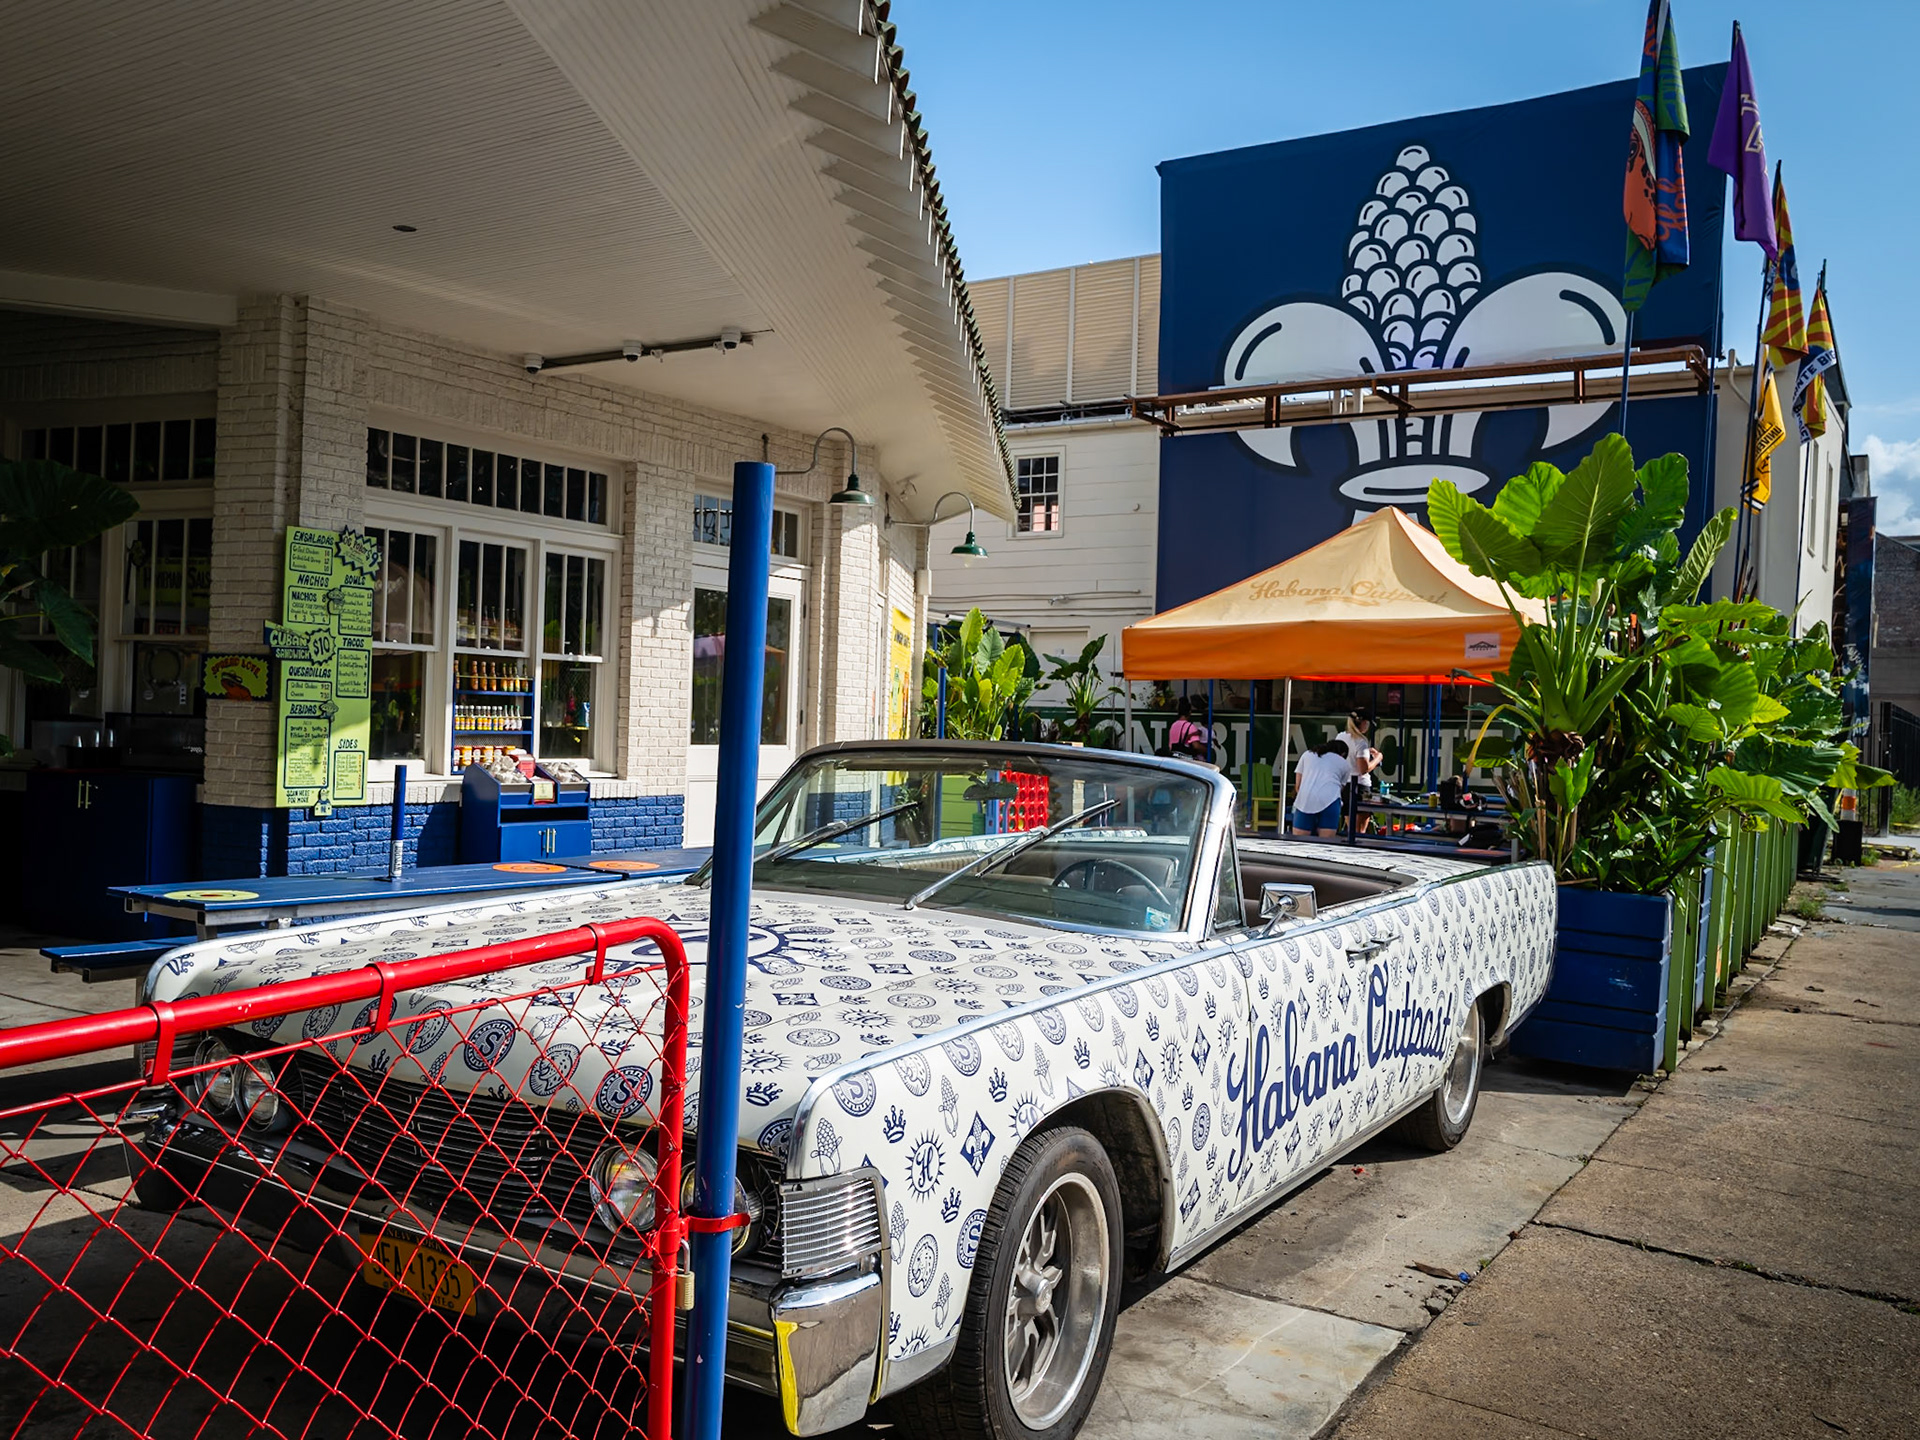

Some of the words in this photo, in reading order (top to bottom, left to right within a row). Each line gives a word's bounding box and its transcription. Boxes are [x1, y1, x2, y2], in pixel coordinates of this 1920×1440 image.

[297, 574, 329, 588] NACHOS
[344, 574, 366, 585] BOWLS
[291, 591, 317, 602] NACHOS
[1249, 579, 1341, 600] Habana
[1351, 580, 1448, 604] Outpost
[269, 629, 308, 647] CUBAN
[342, 637, 365, 648] TACOS
[288, 665, 331, 678] QUESADILLAS
[290, 703, 317, 715] BEBIDAS
[338, 739, 358, 749] SIDES
[1226, 1000, 1361, 1182] Habana
[1367, 959, 1453, 1083] Outpost
